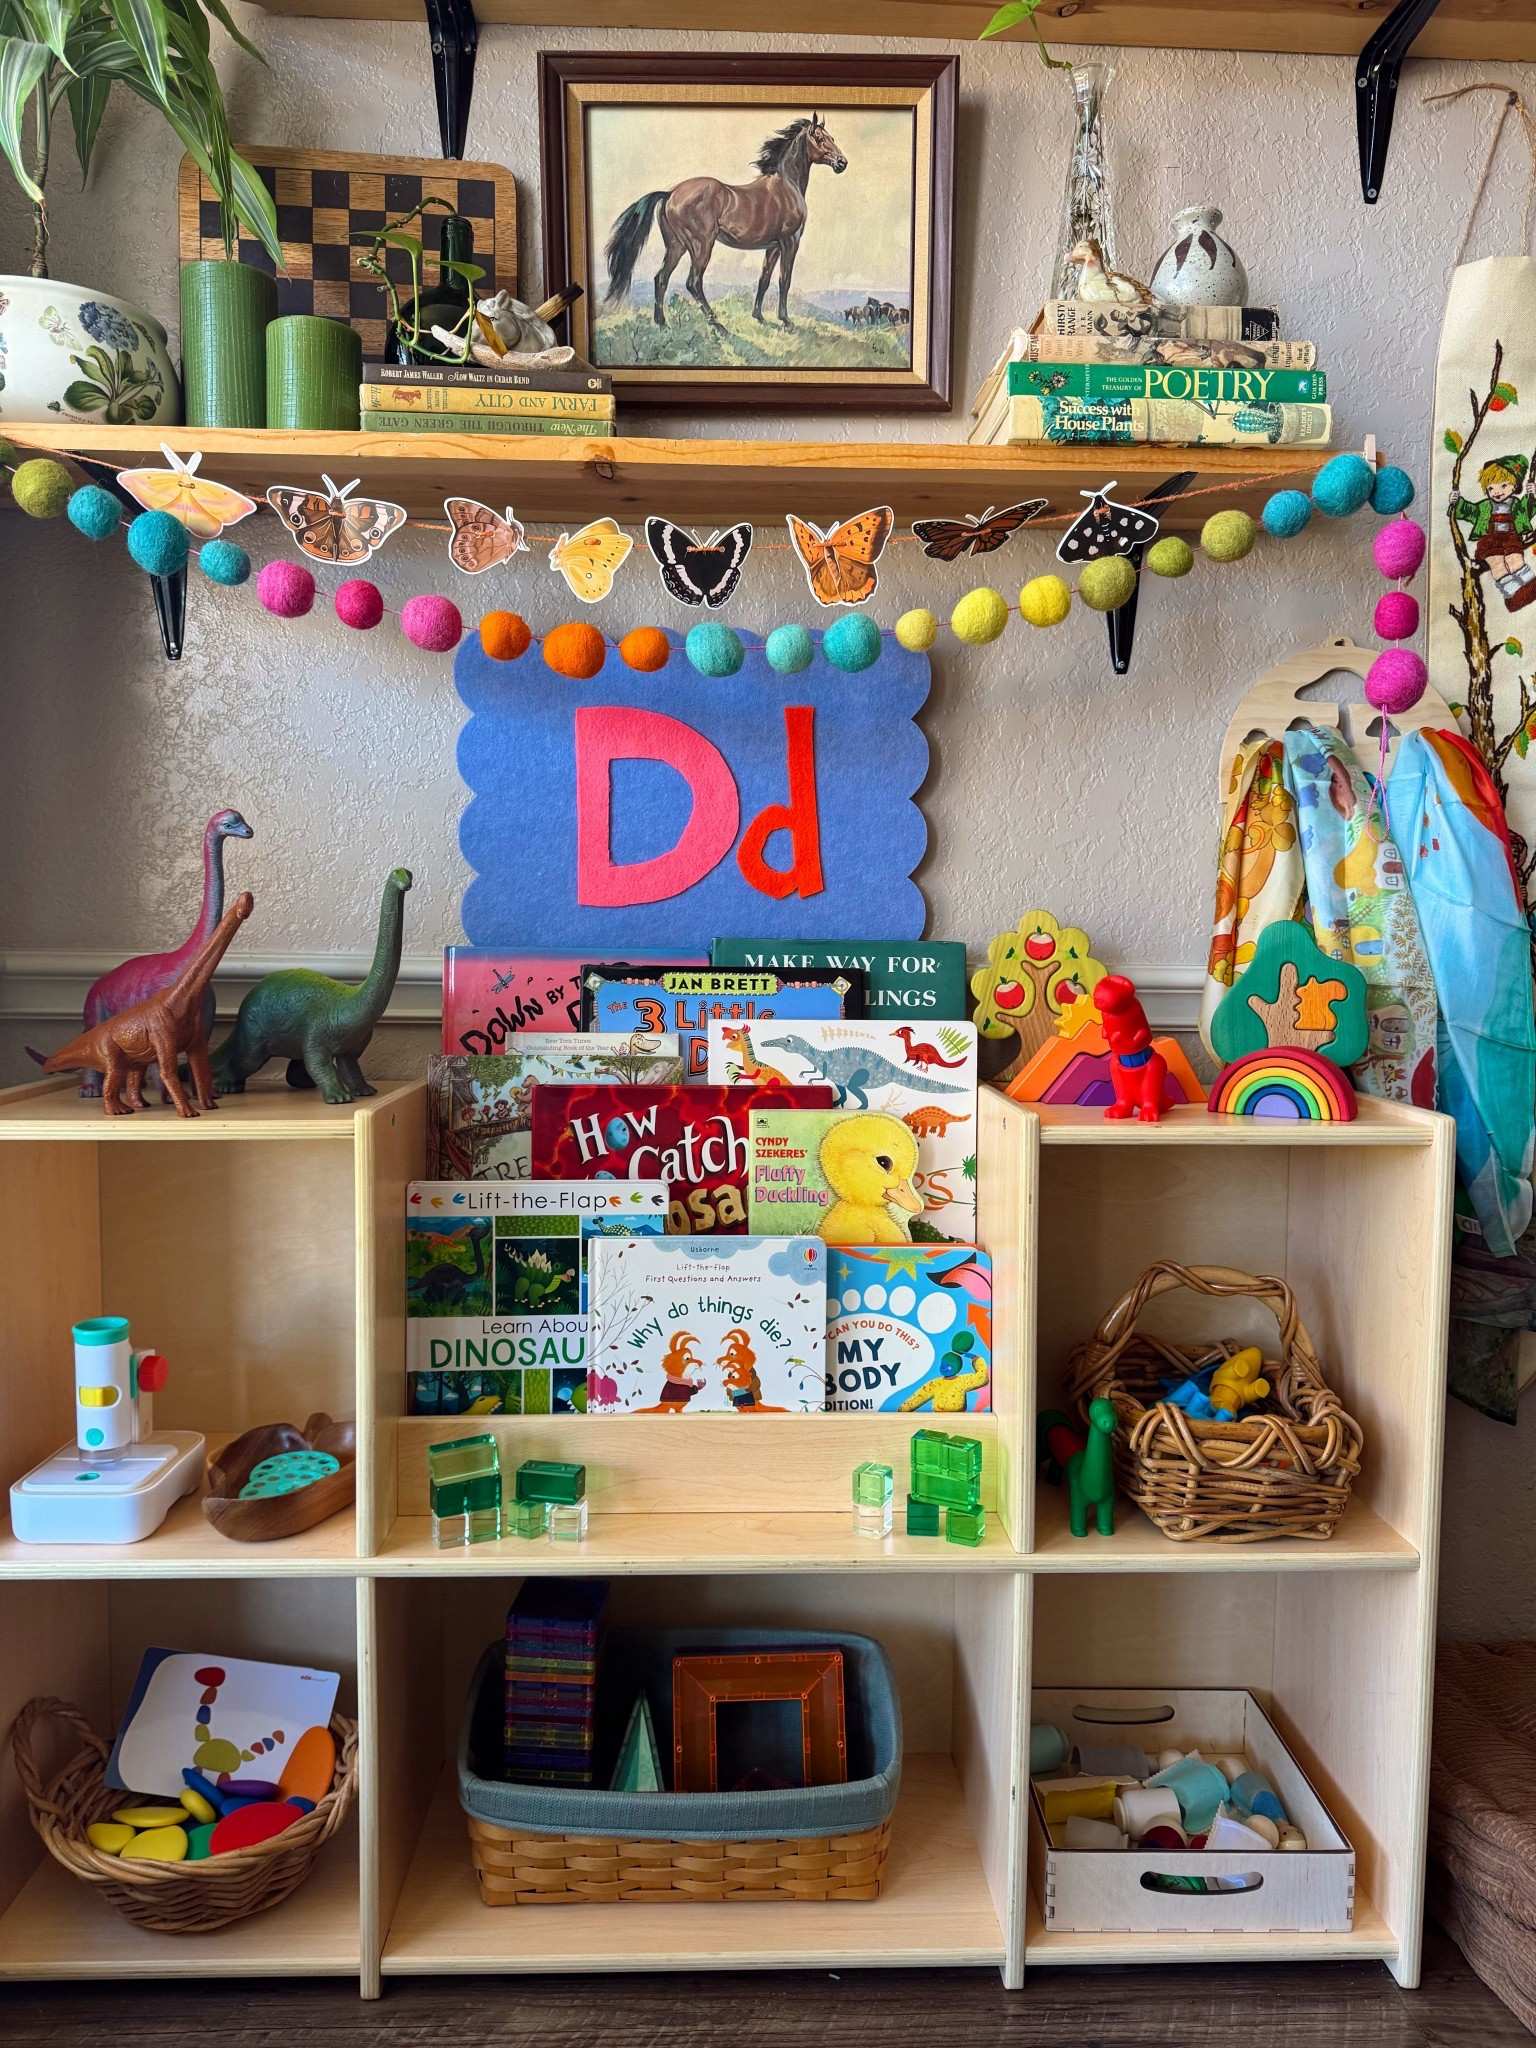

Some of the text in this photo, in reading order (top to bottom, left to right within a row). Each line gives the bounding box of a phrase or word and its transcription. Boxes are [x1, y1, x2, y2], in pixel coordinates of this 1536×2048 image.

[1057, 303, 1066, 336] HIRSTY
[1030, 335, 1039, 362] MUSTAN
[380, 368, 402, 377] ROBERT
[403, 370, 421, 379] JAMES
[422, 370, 444, 380] WALLER
[468, 373, 486, 382] WALTZ
[494, 374, 513, 384] CEDAR
[514, 375, 530, 384] BEND
[1118, 376, 1143, 384] GOLDEN
[1144, 368, 1275, 401] POETRY
[370, 385, 382, 408] Heath
[475, 393, 597, 413] FARM AND CITY
[1059, 400, 1140, 416] Success with
[380, 416, 597, 436] The New THROUGH THE GREEN GATE
[1055, 415, 1145, 432] House Plants
[745, 954, 937, 974] MAKE WAY FOR
[669, 977, 770, 991] JAN BRETT
[864, 989, 937, 1007] LINGS
[459, 995, 544, 1055] DOWN
[546, 985, 564, 1005] BY
[633, 997, 668, 1033] 3
[628, 1116, 749, 1184] Catch
[755, 1137, 789, 1147] CYNDY
[755, 1149, 808, 1159] SZEKERES'
[755, 1164, 806, 1183] Fluffy
[468, 1192, 607, 1212] Lift-the-Flap
[754, 1186, 829, 1207] Duckling
[676, 1263, 731, 1272] Lift-the-flap
[645, 1274, 762, 1284] First Questions and Answers
[482, 1317, 588, 1335] Learn Abou
[627, 1295, 792, 1350] Why do things die?
[828, 1320, 921, 1350] CAN YOU DO THIS?
[430, 1337, 586, 1369] DINOSAU
[837, 1337, 884, 1365] MY
[825, 1362, 902, 1396] BODY
[825, 1398, 874, 1411] DITION!
